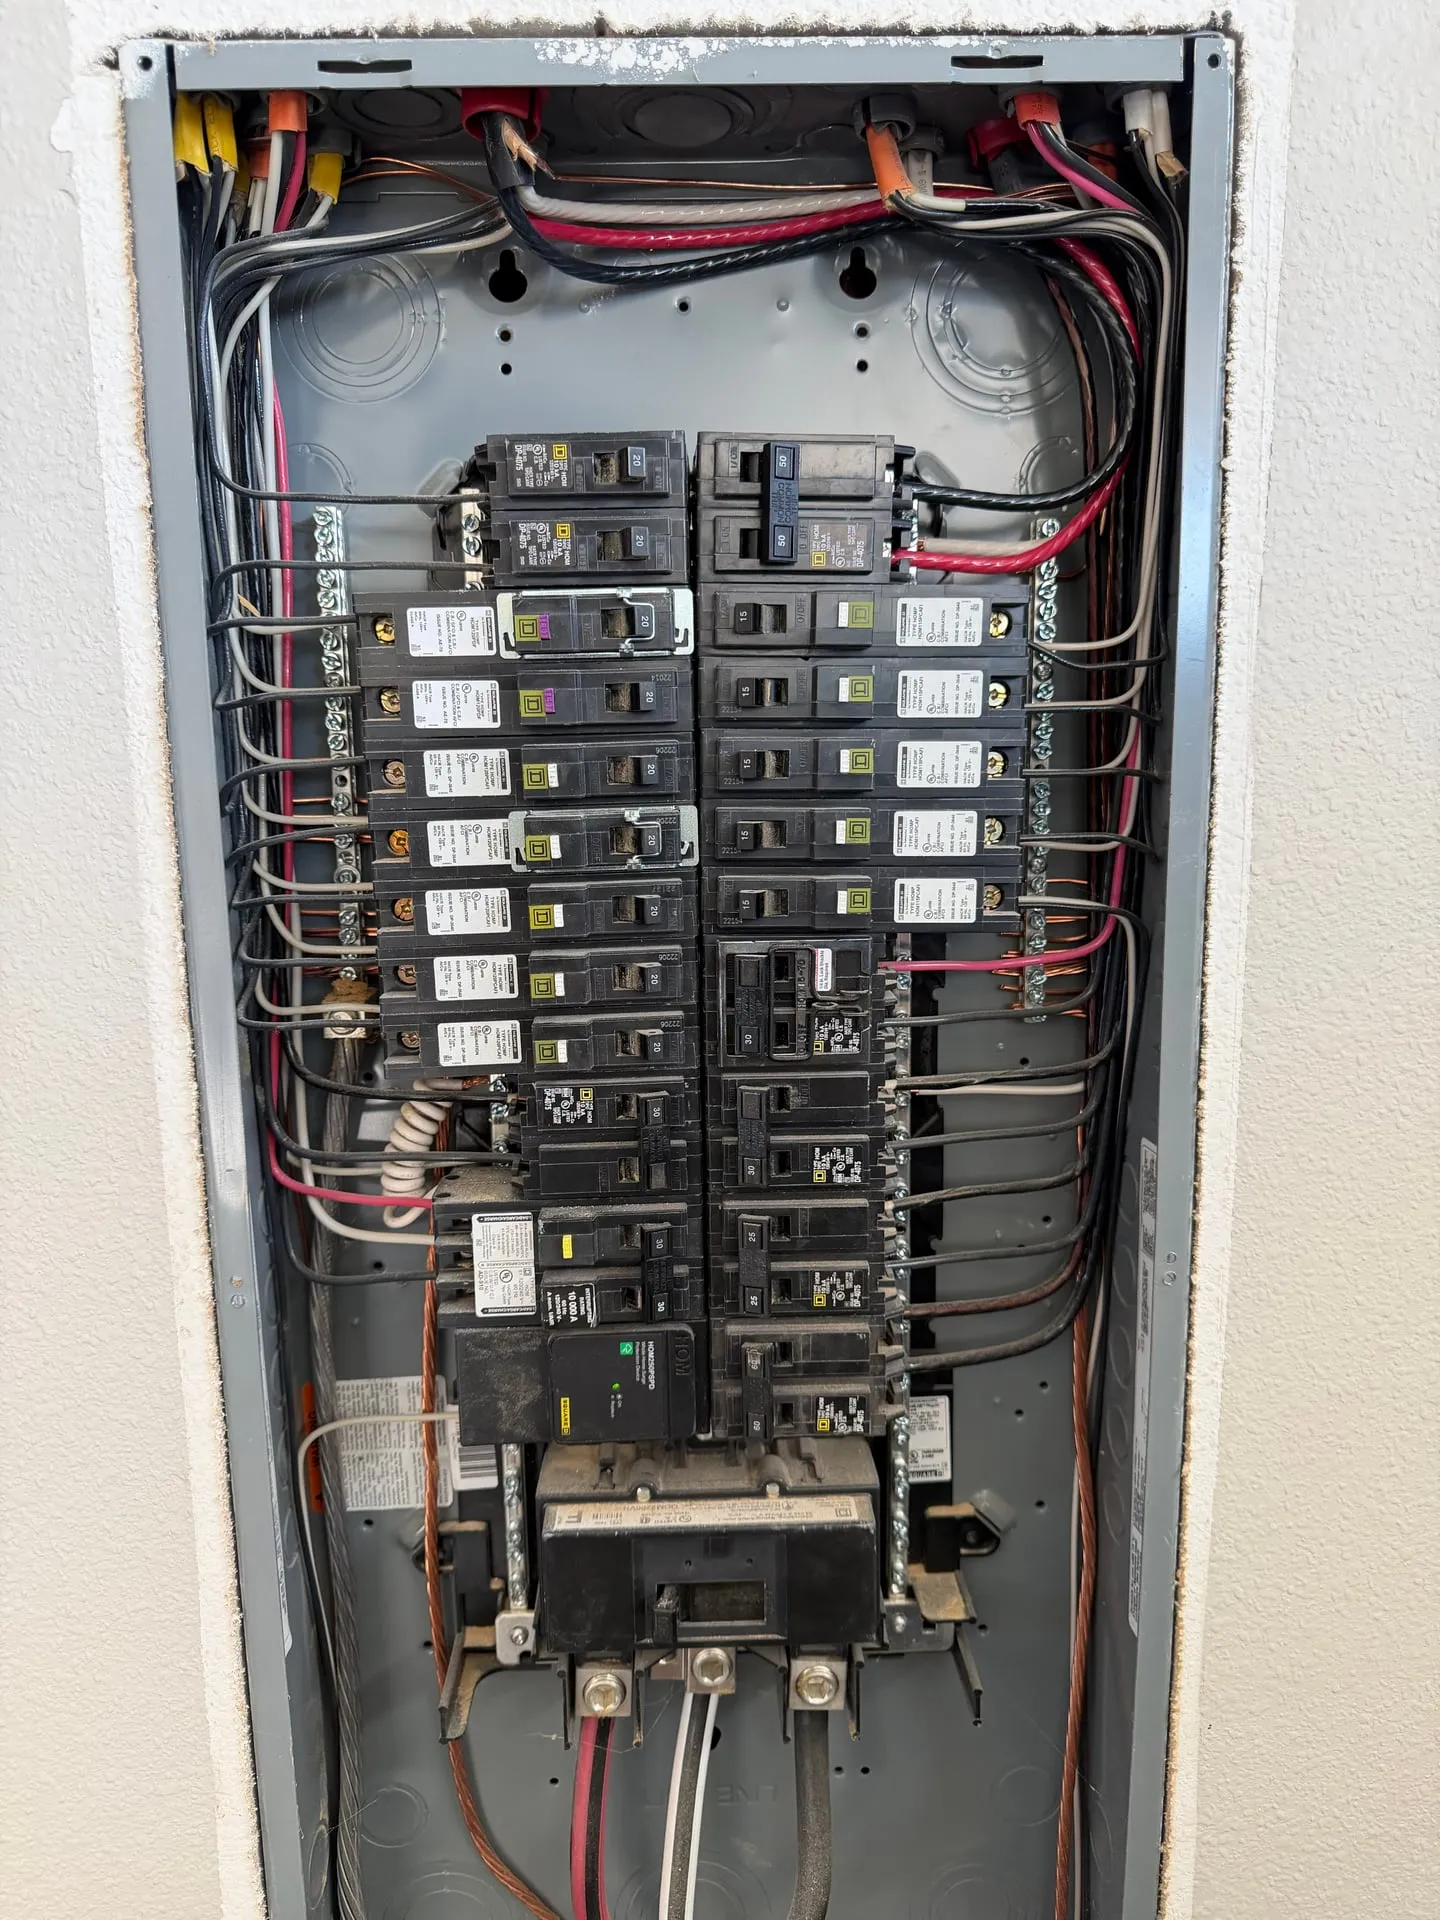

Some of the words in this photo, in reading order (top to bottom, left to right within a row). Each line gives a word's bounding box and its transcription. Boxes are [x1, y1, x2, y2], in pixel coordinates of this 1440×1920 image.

[515, 444, 523, 471] DP-4075
[632, 454, 641, 467] 20
[778, 455, 787, 468] 50
[518, 523, 527, 549] DP-4075
[635, 534, 644, 547] 20
[777, 534, 786, 547] 50
[640, 615, 649, 627] 20
[740, 610, 748, 622] 15
[645, 691, 654, 703] 20
[742, 686, 750, 697] 15
[655, 746, 676, 754] 22206
[743, 758, 751, 769] 15
[647, 764, 656, 775] 20
[648, 834, 656, 846] 20
[741, 830, 749, 841] 15
[742, 899, 750, 910] 15
[650, 905, 659, 917] 20
[658, 953, 679, 961] 22206
[650, 974, 659, 985] 20
[660, 1020, 681, 1028] 22206
[744, 1034, 752, 1045] 30
[653, 1042, 661, 1053] 20
[652, 1106, 661, 1117] 30
[747, 1165, 756, 1176] 30
[748, 1231, 756, 1242] 25
[656, 1238, 664, 1249] 30
[568, 1291, 577, 1300] 10
[750, 1295, 758, 1306] 25
[569, 1301, 578, 1315] 000
[657, 1301, 665, 1312] 30
[675, 1336, 691, 1376] HOM
[753, 1420, 761, 1431] 60
